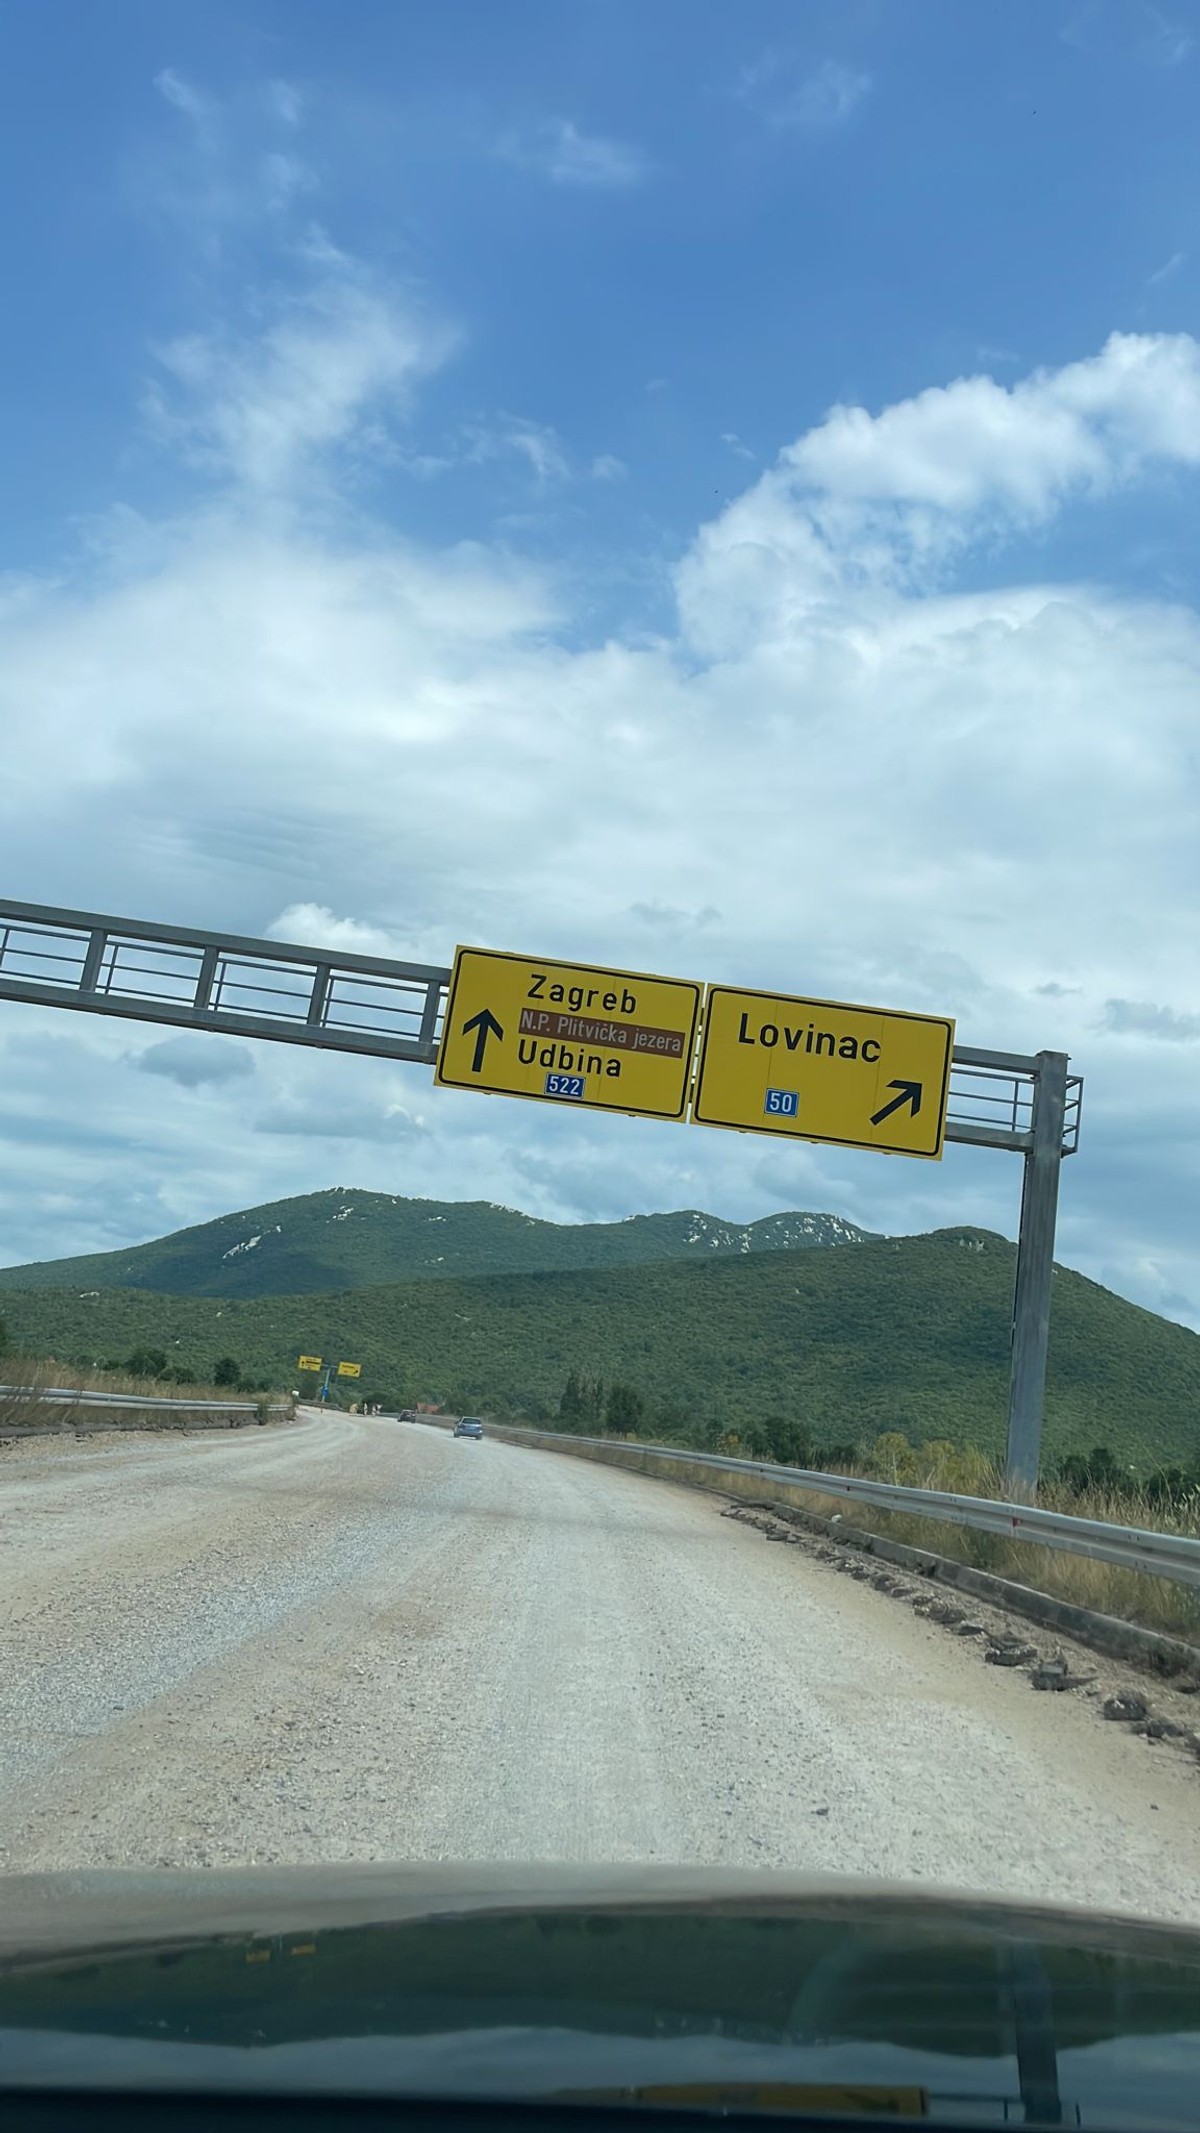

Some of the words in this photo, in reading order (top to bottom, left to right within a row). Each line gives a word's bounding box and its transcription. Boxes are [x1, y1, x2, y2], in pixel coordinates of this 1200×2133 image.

[527, 974, 637, 1014] Zagreb
[521, 1011, 551, 1032] N.P.
[557, 1016, 627, 1044] Plitvička
[632, 1027, 682, 1052] jezera
[738, 1012, 881, 1063] Lovinac
[518, 1039, 621, 1077] Udbina
[548, 1075, 581, 1096] 522
[769, 1092, 793, 1113] 50
